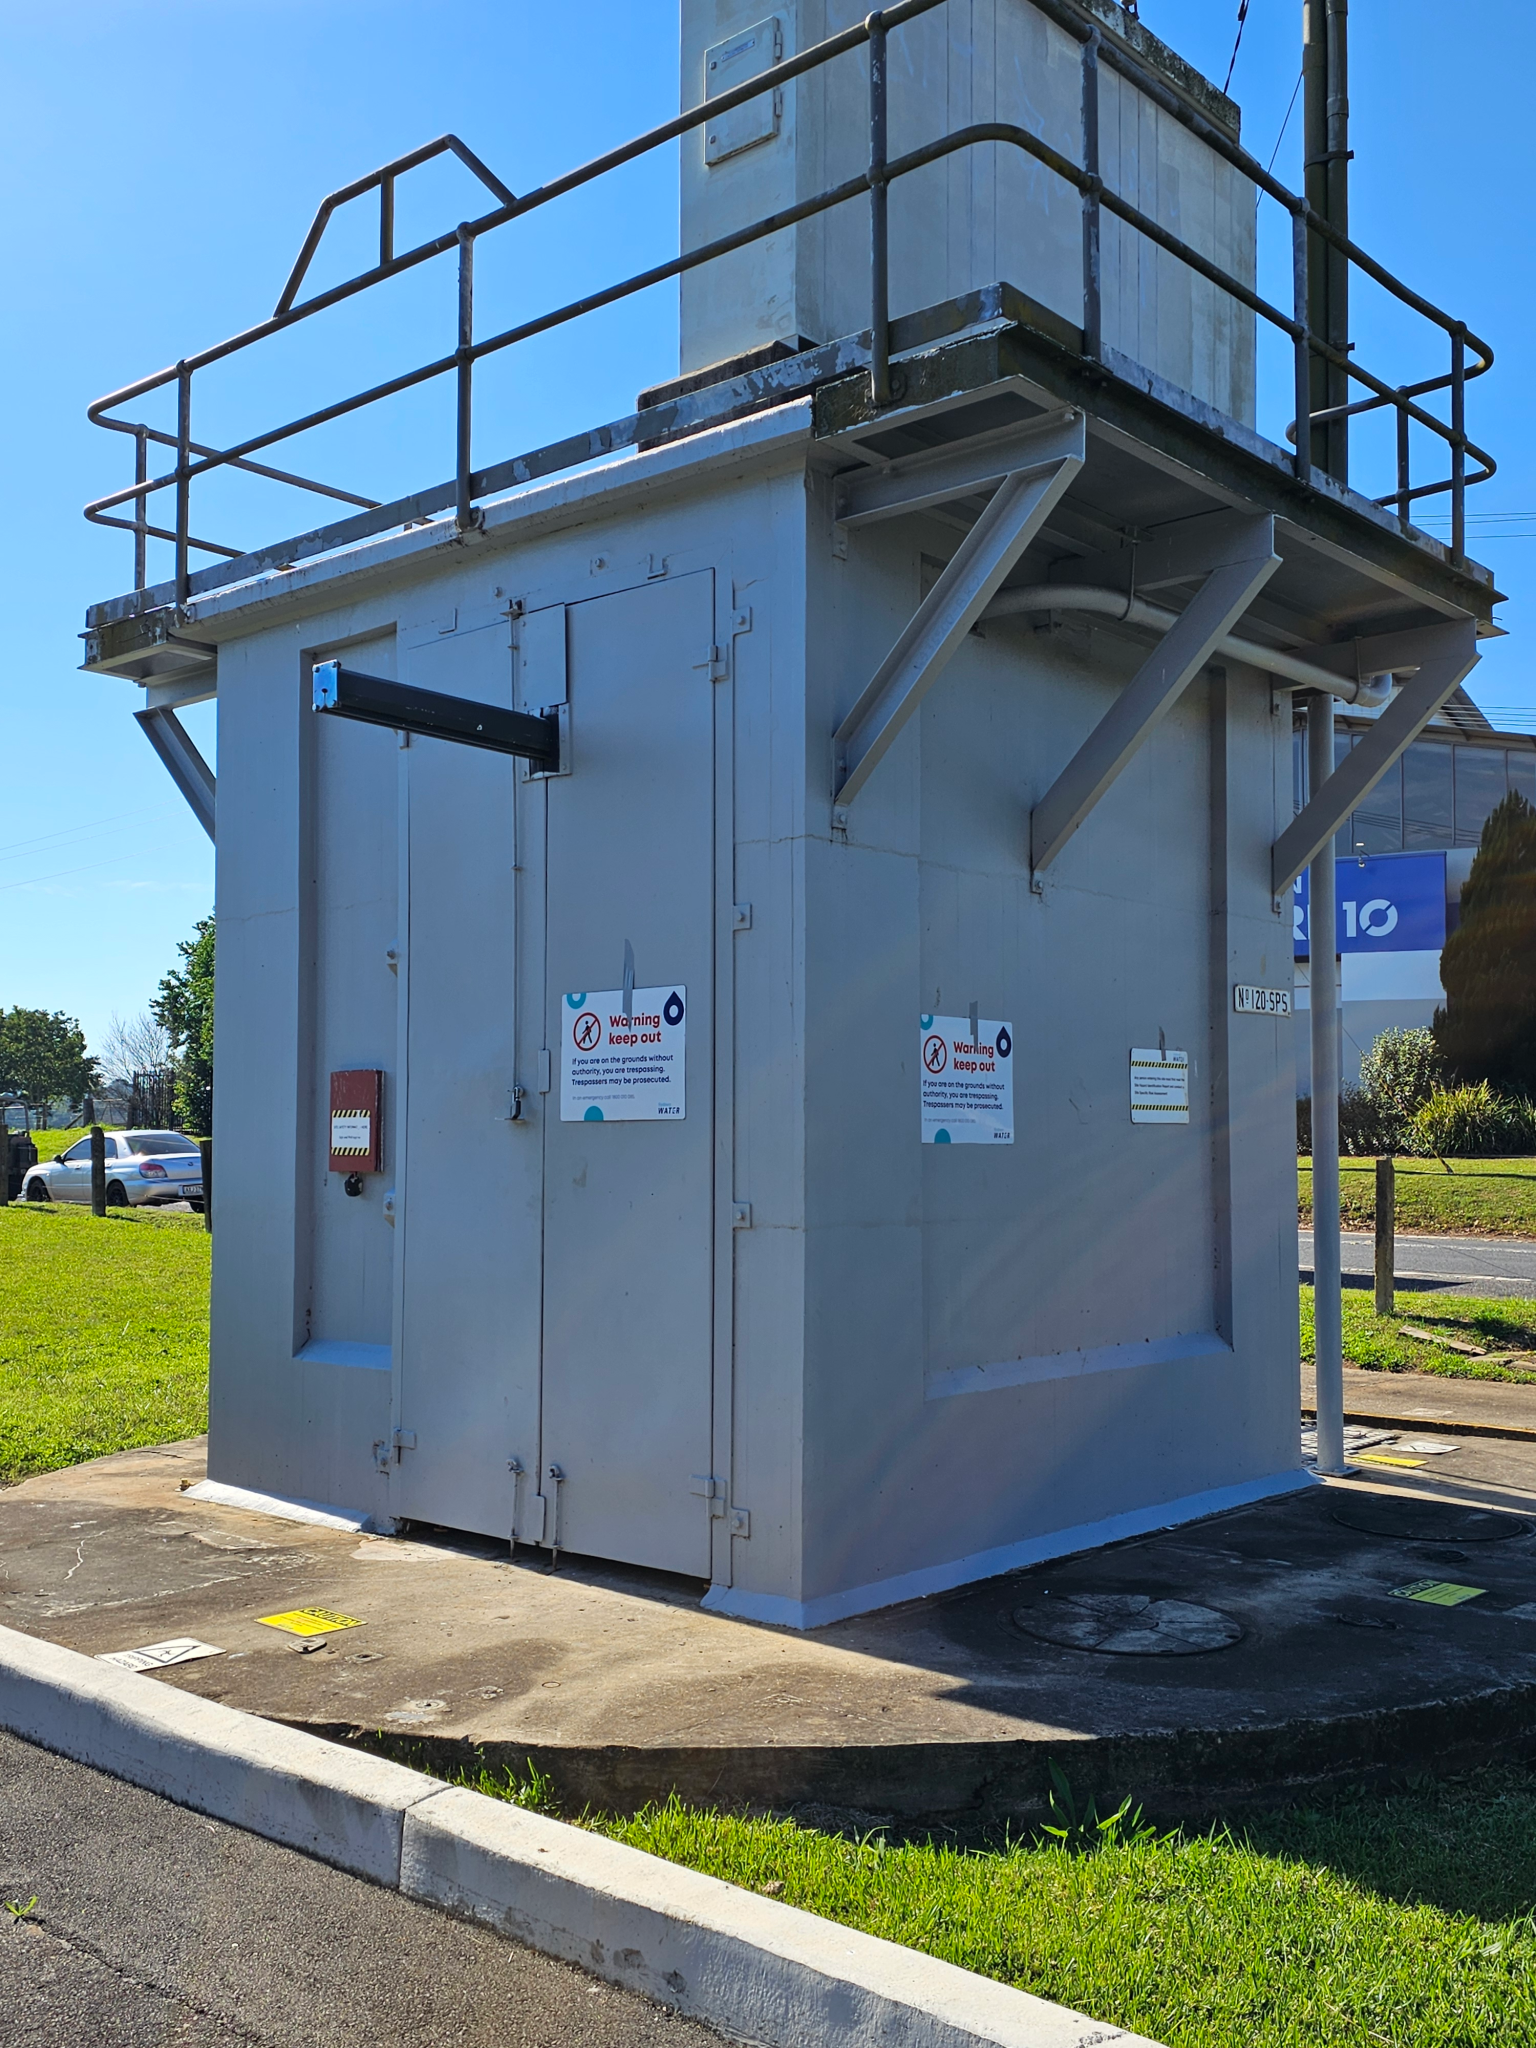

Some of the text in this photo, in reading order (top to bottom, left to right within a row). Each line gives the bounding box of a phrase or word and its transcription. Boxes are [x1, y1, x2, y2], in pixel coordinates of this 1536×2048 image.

[1342, 898, 1399, 937] 10
[609, 1012, 661, 1029] Waning
[608, 1030, 661, 1047] keep out
[572, 1057, 577, 1065] If
[577, 1058, 589, 1067] you
[610, 1056, 620, 1064] the
[621, 1055, 648, 1065] grounds
[648, 1053, 674, 1062] without
[953, 1057, 996, 1074] keep out
[571, 1067, 602, 1076] authority,
[602, 1068, 614, 1076] you
[626, 1064, 666, 1074] trespassing.
[571, 1075, 672, 1087] Trespassers may be prosecuted.
[927, 1080, 938, 1089] you
[955, 1081, 964, 1089] the
[964, 1082, 985, 1091] grounds
[948, 1092, 959, 1100] you
[657, 1106, 681, 1115] WATER
[922, 1100, 954, 1109] Trespassers
[954, 1102, 966, 1110] may
[966, 1101, 974, 1109] be
